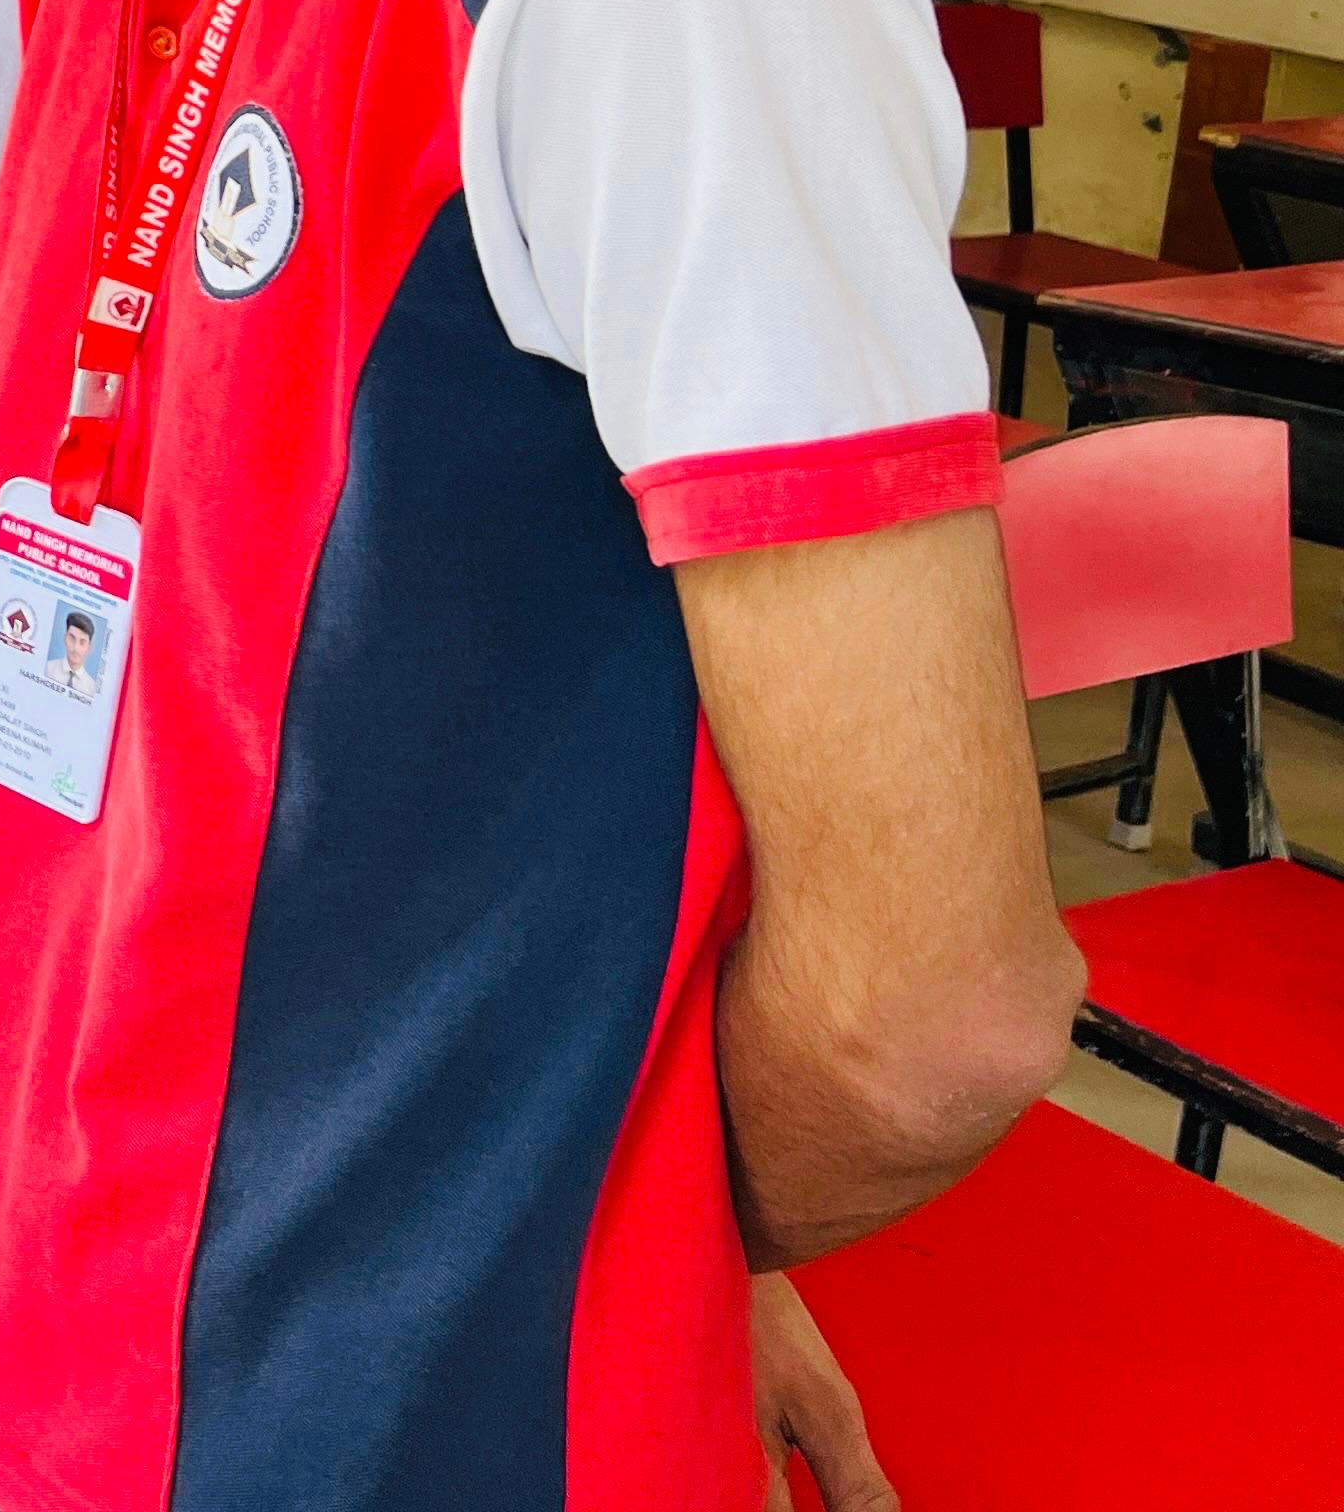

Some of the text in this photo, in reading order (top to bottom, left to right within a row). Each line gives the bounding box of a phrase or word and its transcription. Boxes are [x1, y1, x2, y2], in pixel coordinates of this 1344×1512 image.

[127, 182, 175, 268] NAND
[157, 80, 209, 178] SINGH
[247, 197, 277, 247] SCHOOL
[1, 518, 126, 579] NAND SINGH MEMORIAL
[17, 542, 57, 568] PUBLIC
[58, 559, 102, 587] SCHOOL
